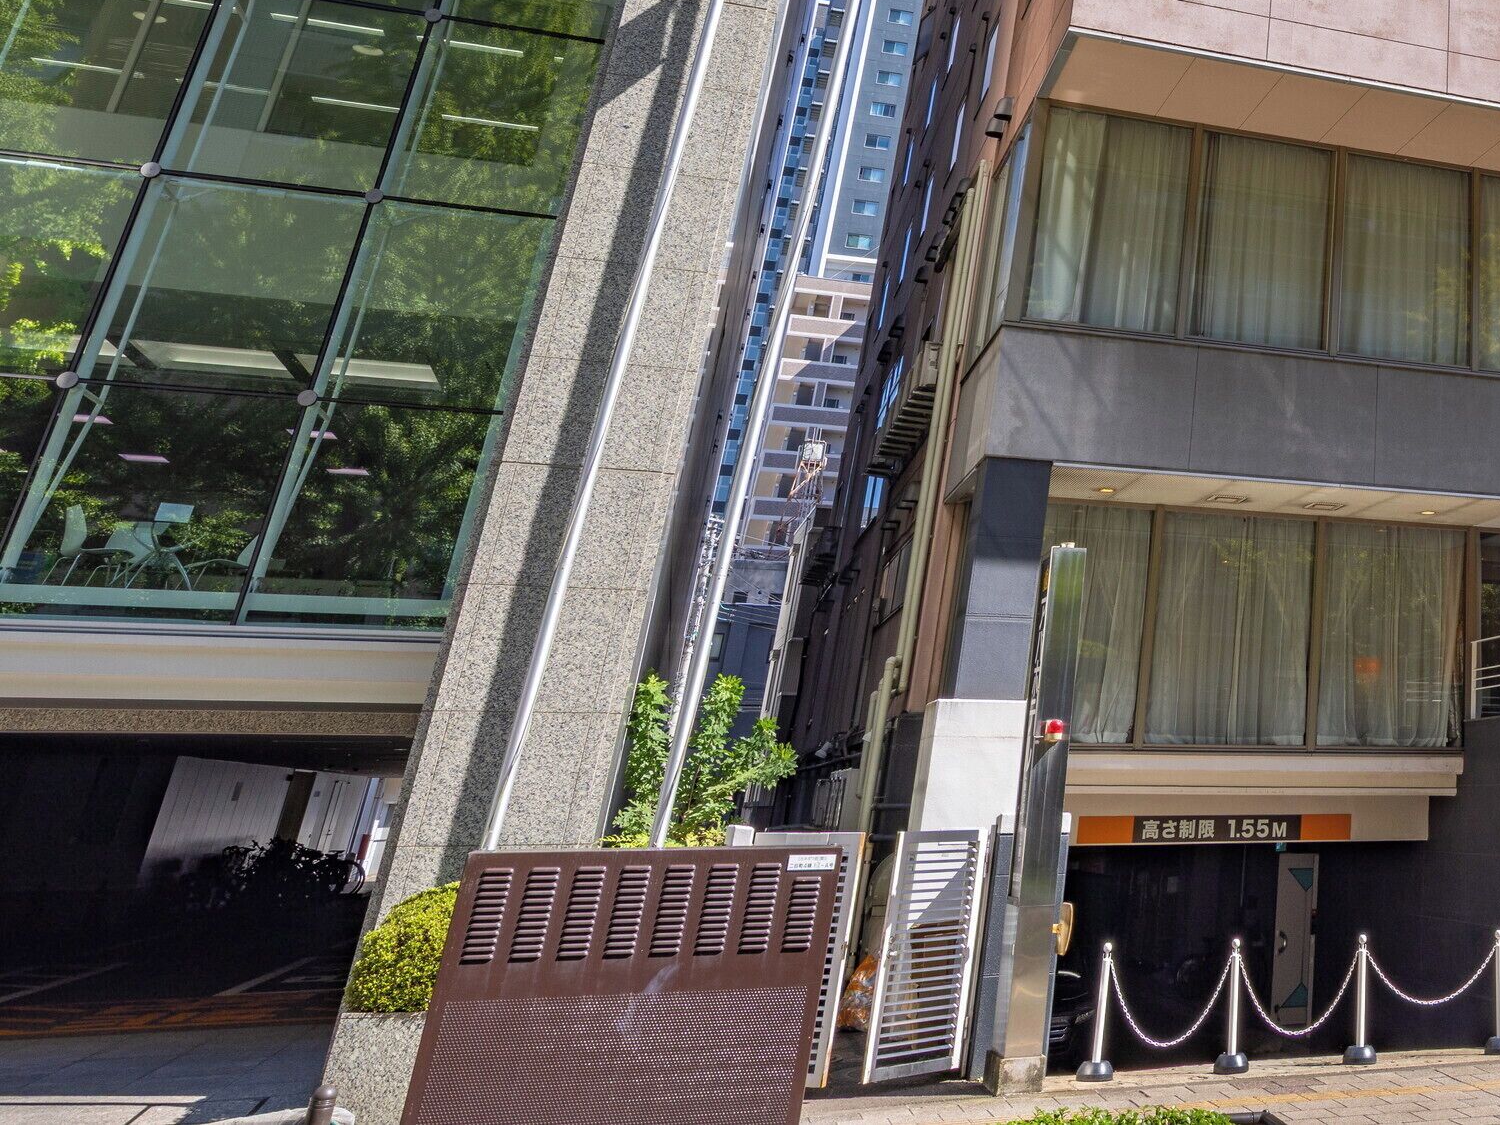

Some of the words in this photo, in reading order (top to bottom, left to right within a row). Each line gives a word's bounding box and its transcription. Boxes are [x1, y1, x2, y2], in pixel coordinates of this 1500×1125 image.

[1141, 819, 1215, 840] 高さ制限
[1227, 819, 1288, 839] 1.55M
